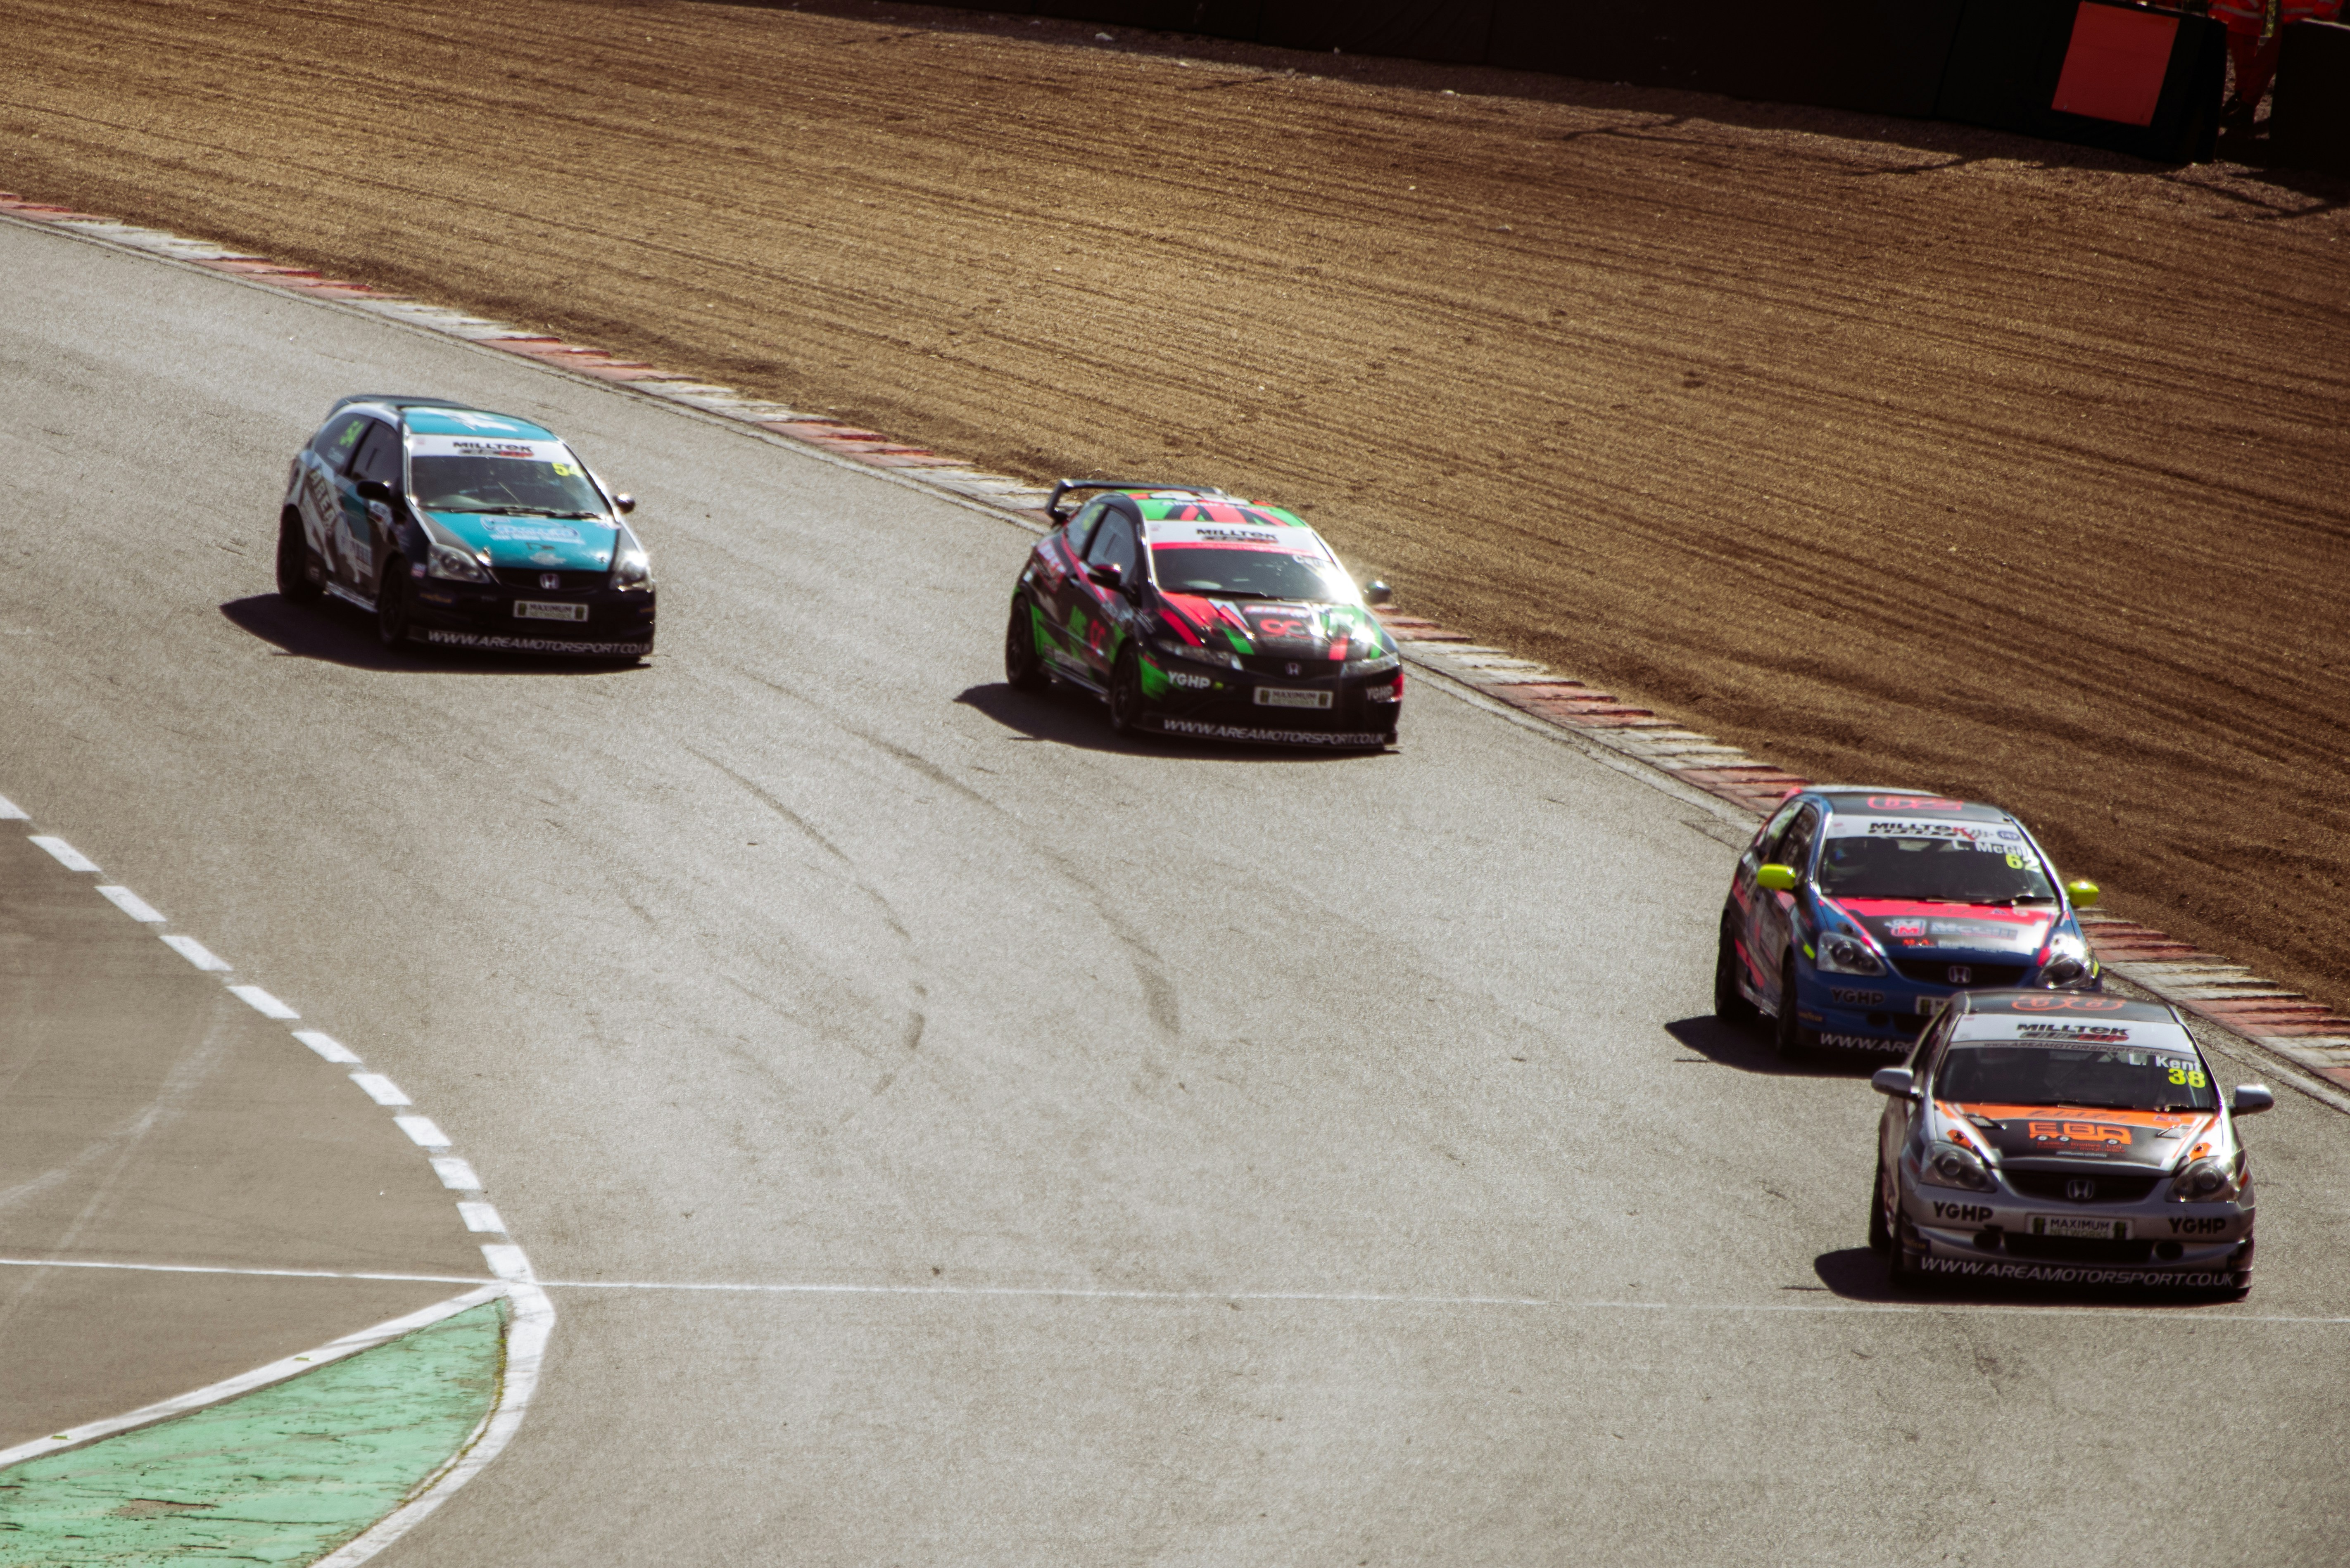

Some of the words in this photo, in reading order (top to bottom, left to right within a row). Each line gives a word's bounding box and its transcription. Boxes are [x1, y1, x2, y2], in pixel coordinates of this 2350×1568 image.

[1167, 671, 1211, 689] YGHP
[1366, 685, 1394, 701] YGHP
[2005, 854, 2040, 873] 62
[1831, 989, 1885, 1006] YGHP
[2155, 1056, 2202, 1073] Kent
[2169, 1068, 2206, 1088] 38
[1934, 1200, 1994, 1222] YGHP
[2050, 1219, 2109, 1230] MAXIMUM
[2168, 1217, 2226, 1234] YGHP
[1921, 1257, 2235, 1286] WWW.AREAMOTORSPORT.CO.UK
